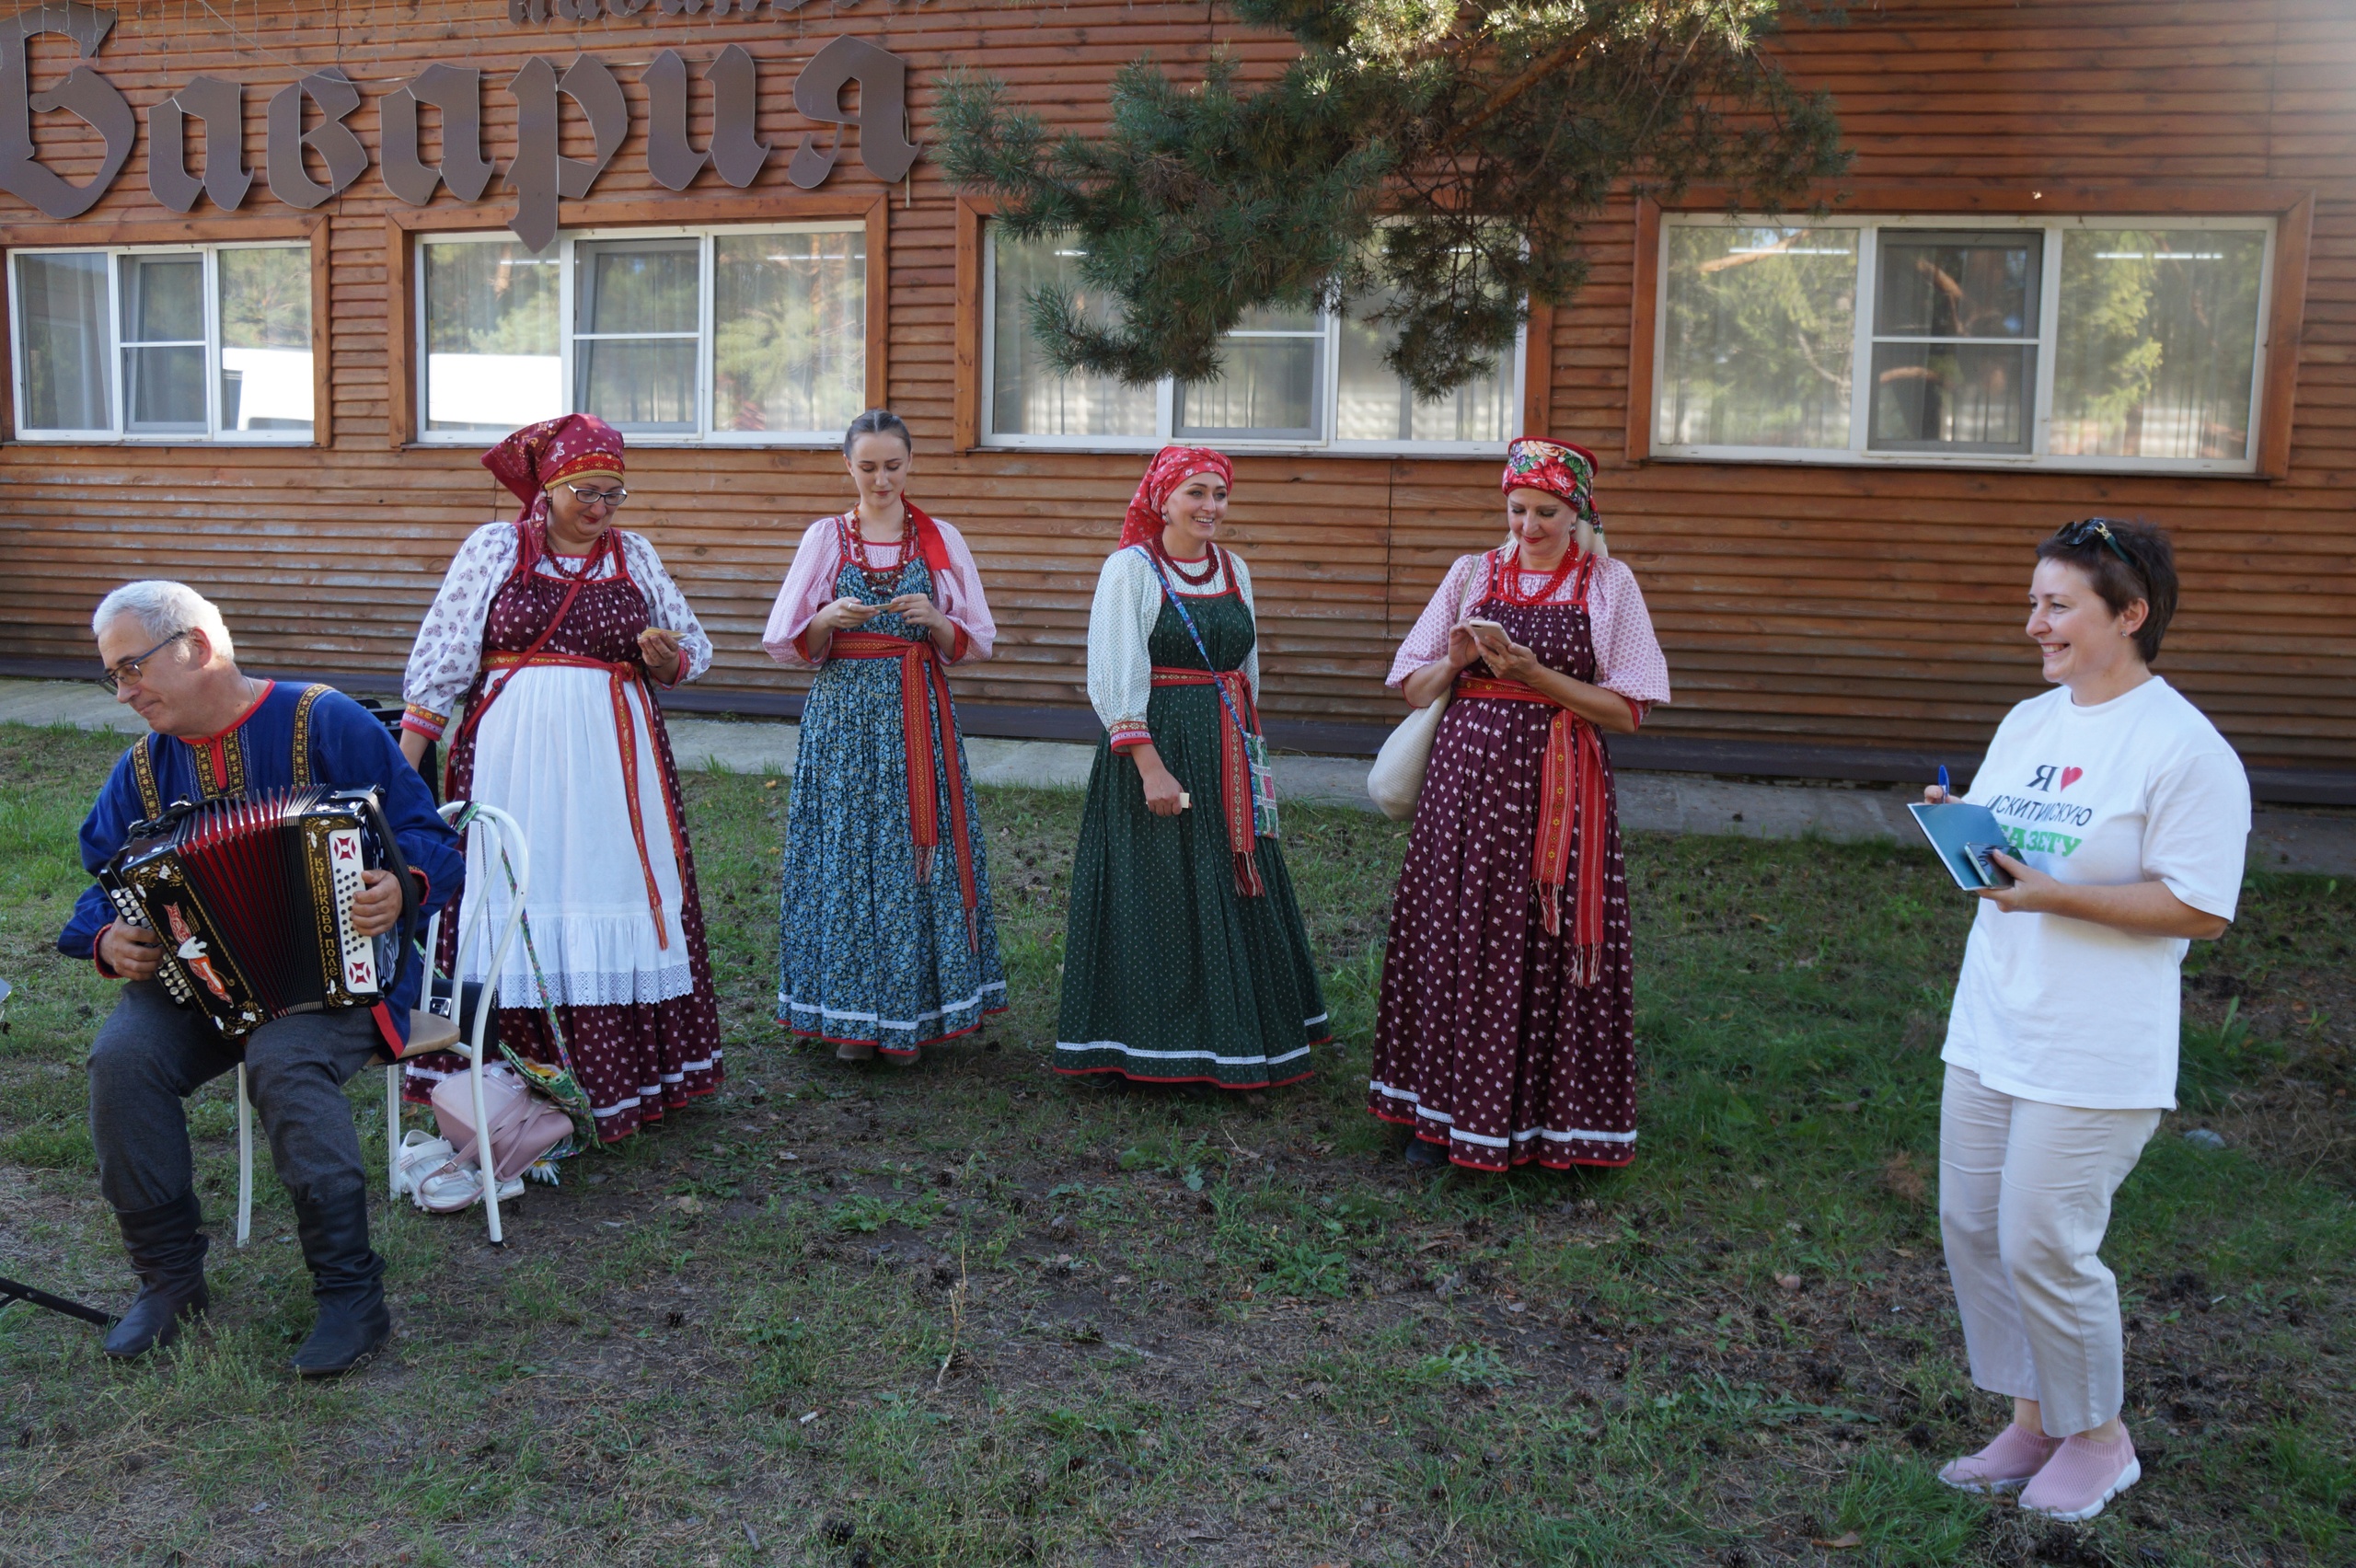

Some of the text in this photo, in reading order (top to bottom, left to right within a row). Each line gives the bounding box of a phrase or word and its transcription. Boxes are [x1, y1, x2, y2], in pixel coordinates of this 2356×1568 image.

[0, 4, 921, 253] Бавария
[2027, 765, 2059, 792] Я
[315, 858, 332, 933] КУЛИКОВО
